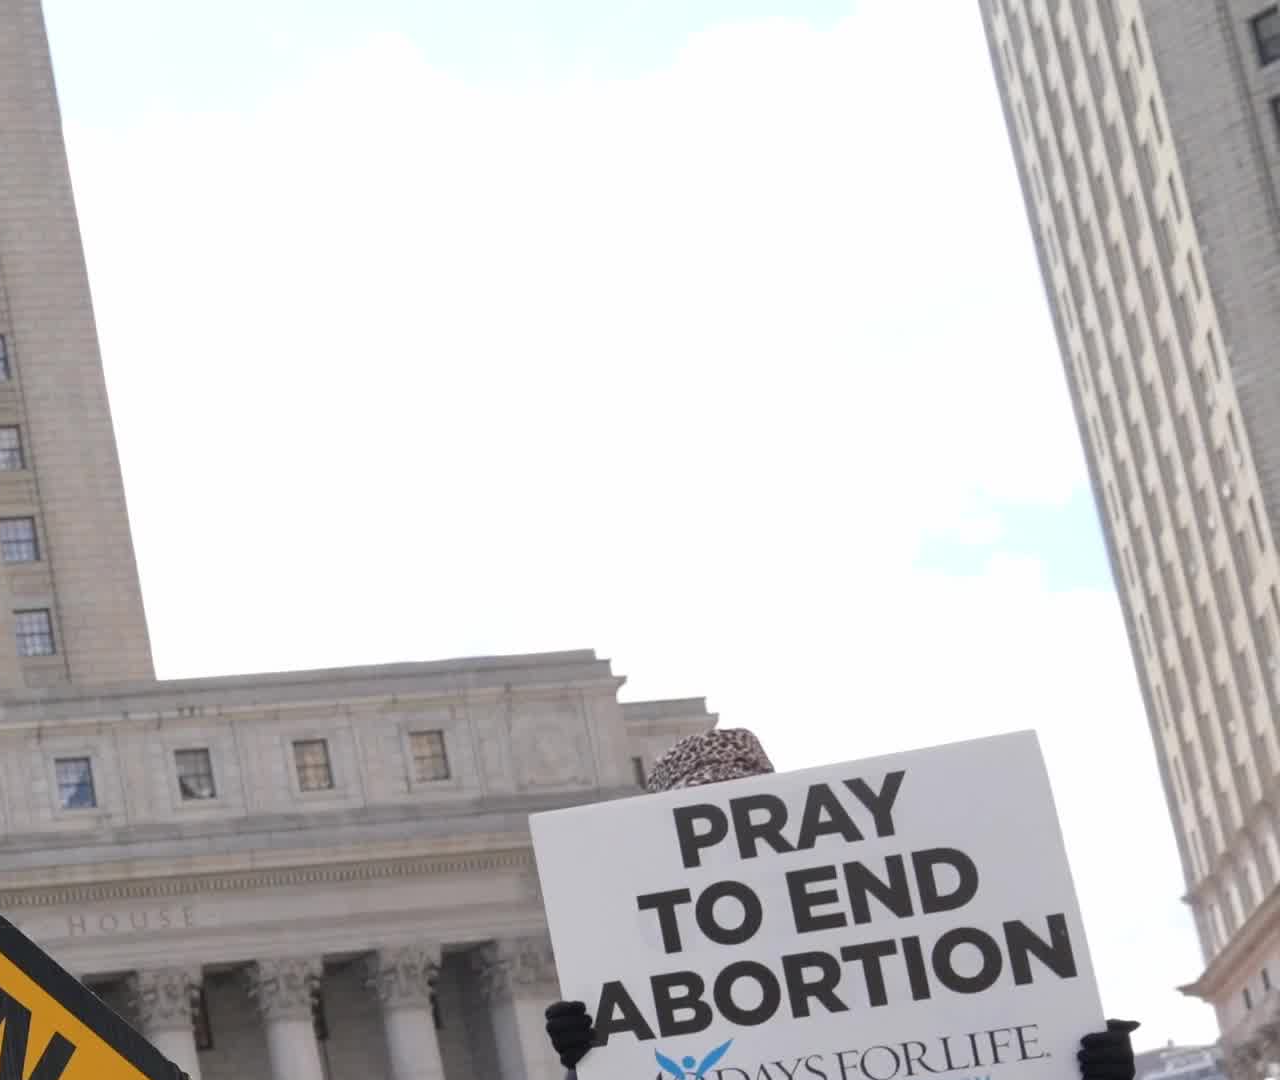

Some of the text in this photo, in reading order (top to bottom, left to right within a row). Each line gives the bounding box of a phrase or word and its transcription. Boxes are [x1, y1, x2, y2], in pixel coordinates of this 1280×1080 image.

[673, 770, 906, 868] PRAY
[66, 905, 194, 937] HOUSE
[637, 847, 979, 954] TO END
[590, 913, 1078, 1048] ABORTION
